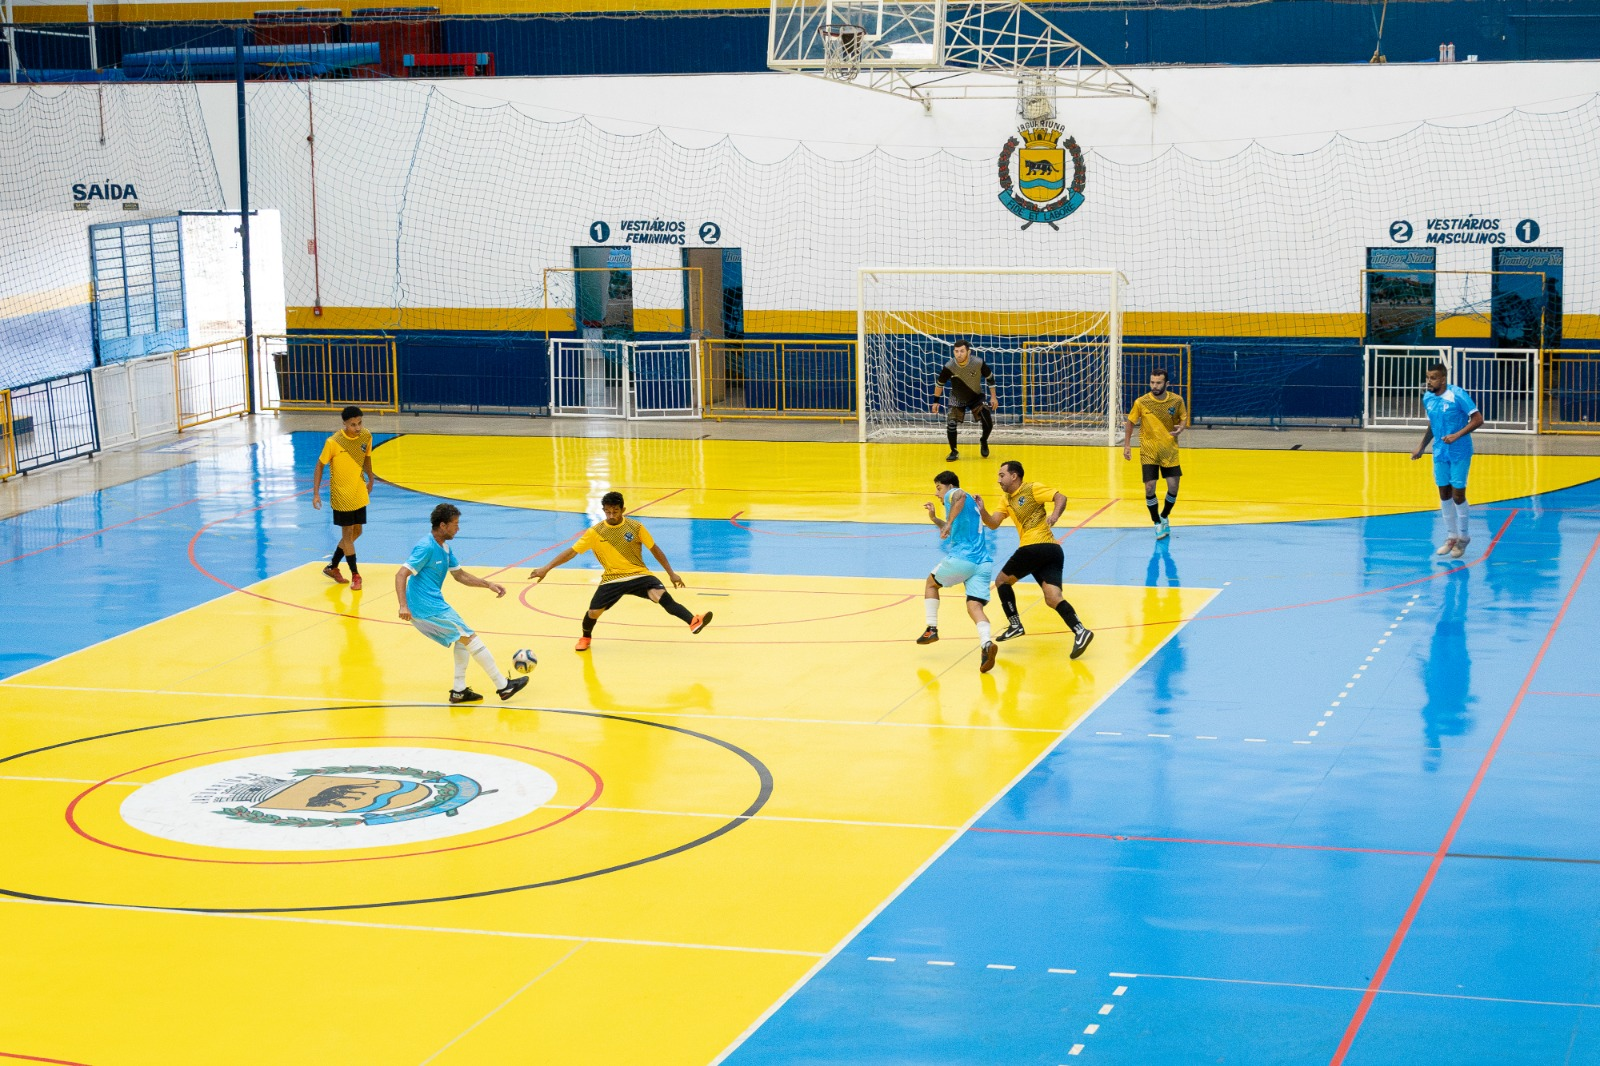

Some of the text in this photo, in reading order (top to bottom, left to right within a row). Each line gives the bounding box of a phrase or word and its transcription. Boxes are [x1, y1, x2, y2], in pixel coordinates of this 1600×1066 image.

[71, 178, 138, 201] SAÍDA
[1007, 200, 1076, 220] FIDE ET LABORE
[620, 217, 686, 232] VESTIÁRIOS
[1426, 214, 1500, 230] VESTIÁRIOS
[625, 233, 686, 245] FEMININOS
[1426, 232, 1506, 244] MASCULINOS
